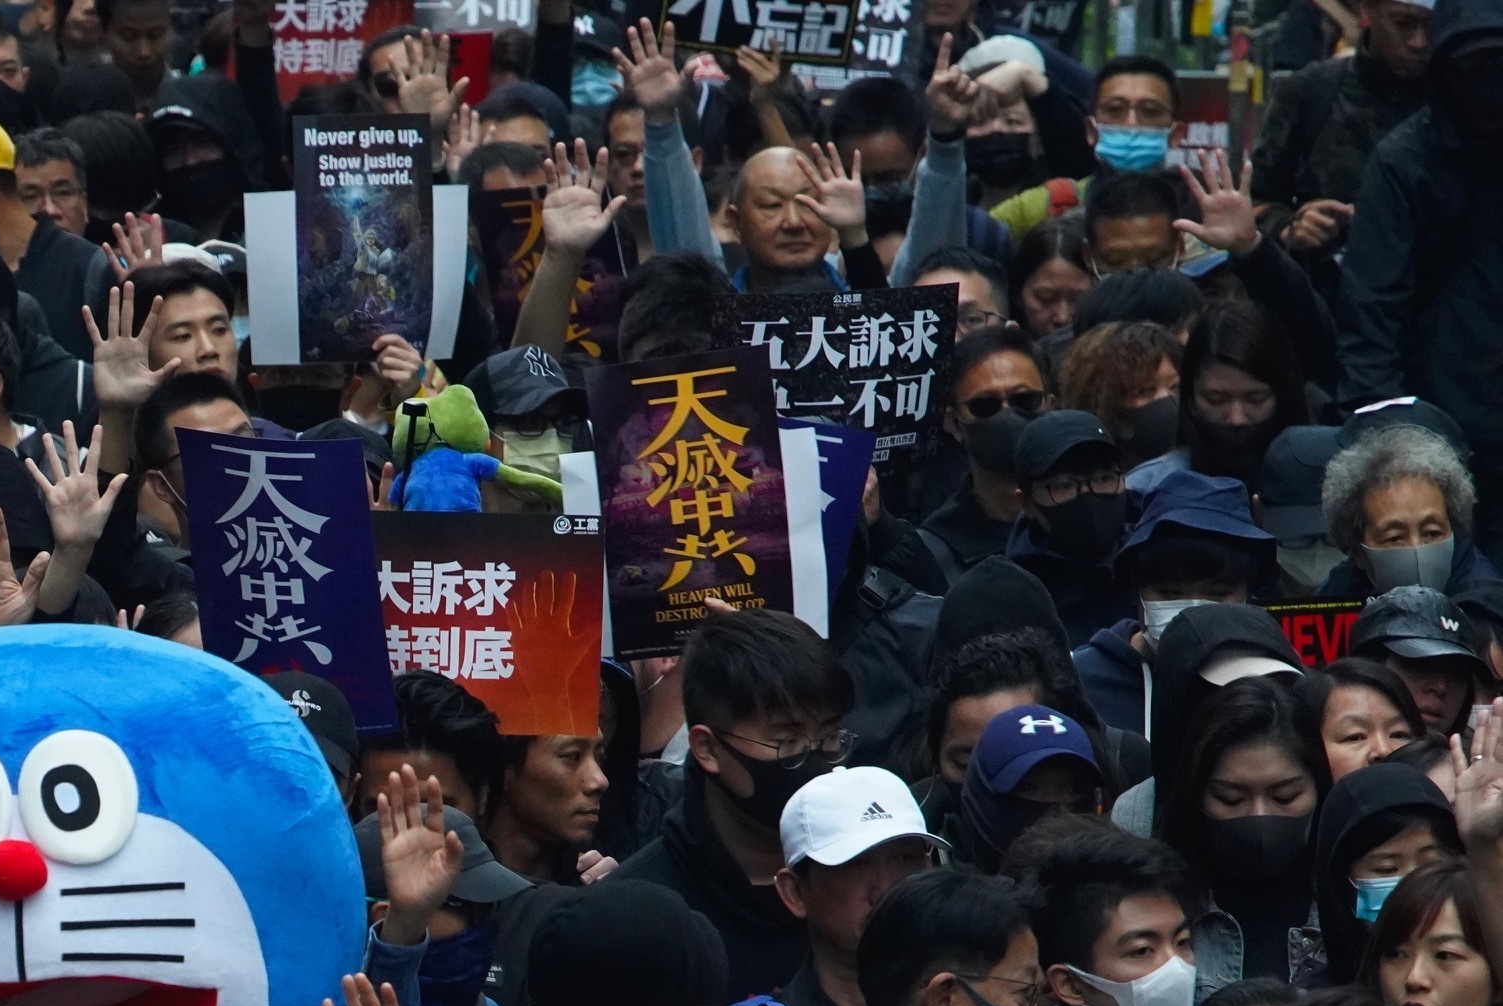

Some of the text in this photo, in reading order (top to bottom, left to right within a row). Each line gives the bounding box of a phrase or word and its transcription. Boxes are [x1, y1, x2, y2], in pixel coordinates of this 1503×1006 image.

[304, 126, 424, 149] Never give up.
[318, 152, 413, 172] Show justice
[319, 170, 414, 187] to the world.
[741, 310, 941, 371] 五大訴求
[630, 365, 759, 592] 天滅中共
[574, 517, 599, 531] 工黨
[210, 443, 336, 666] 天滅中共
[723, 582, 755, 599] WILL
[655, 605, 710, 623] DESTRO
[860, 812, 894, 823] adidas
